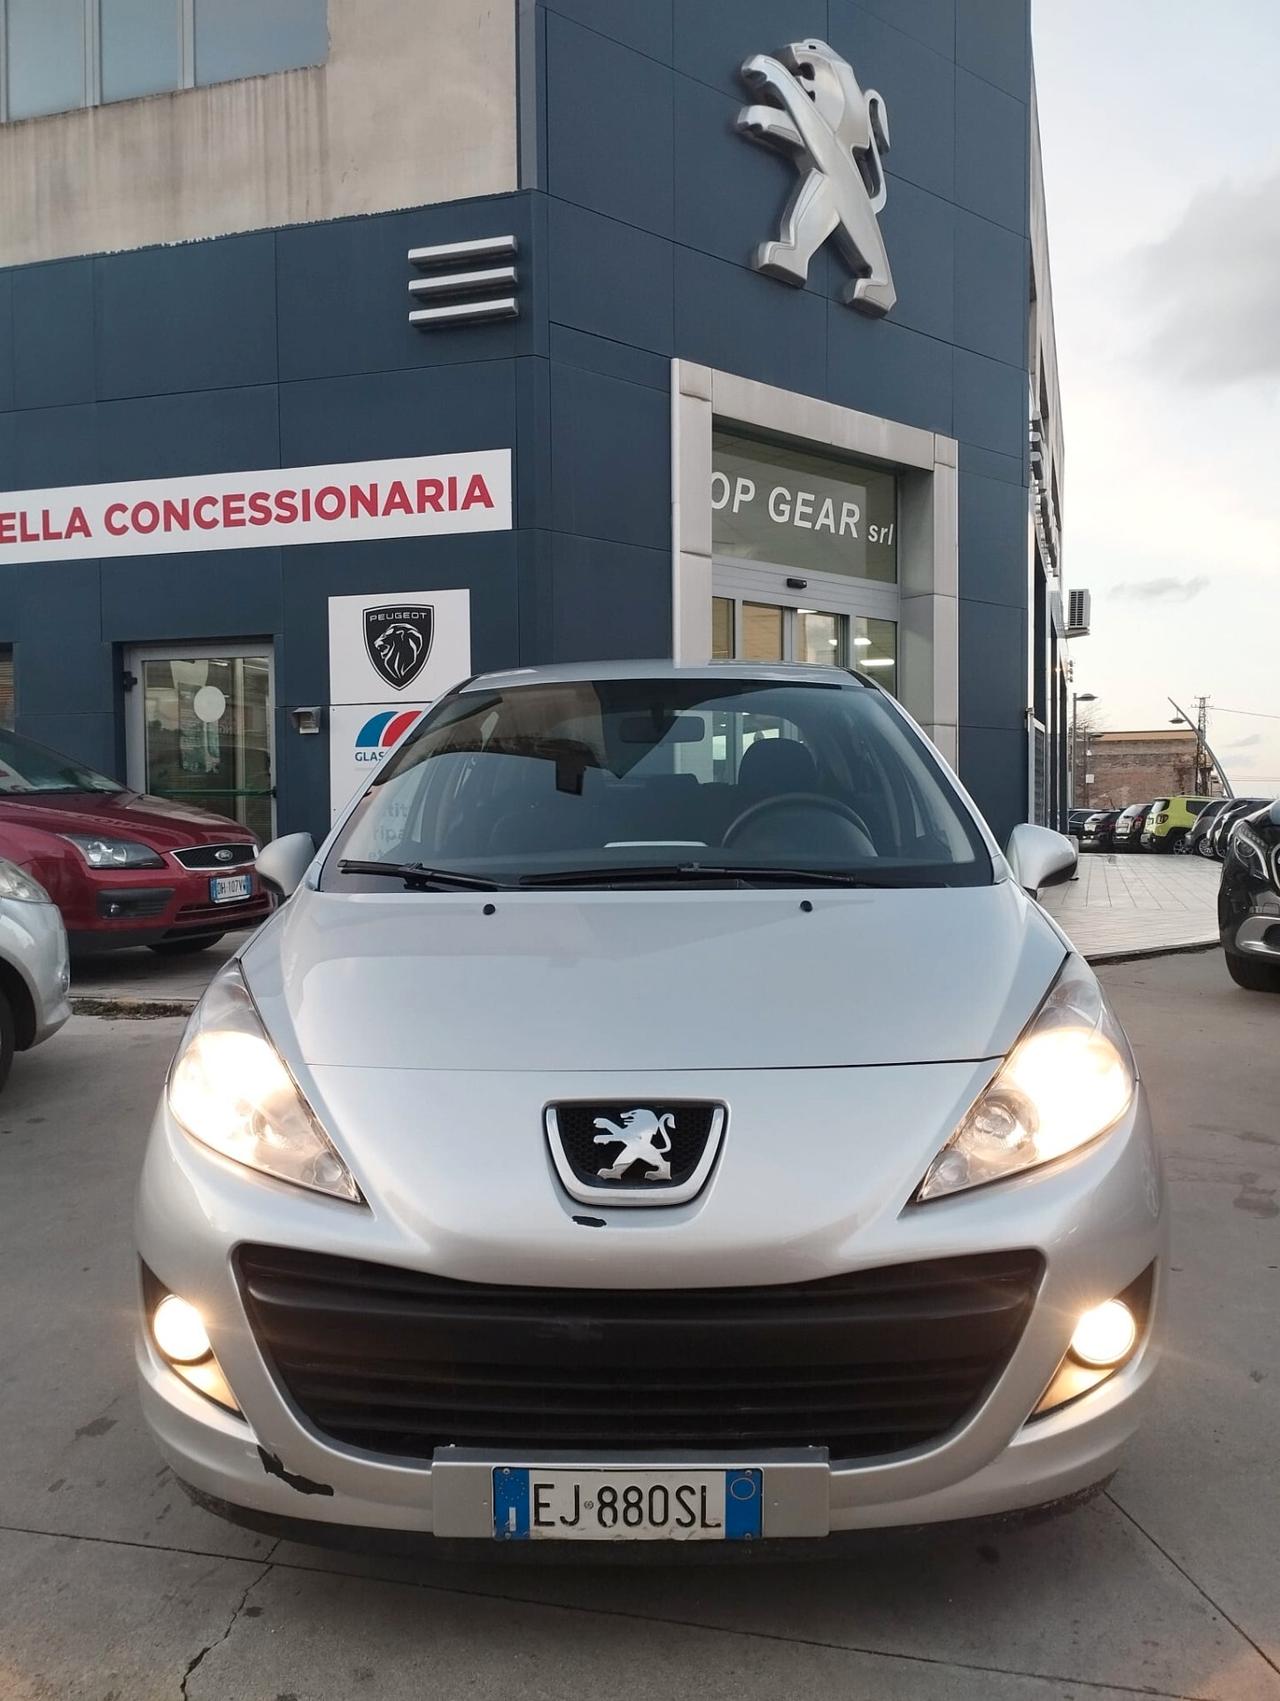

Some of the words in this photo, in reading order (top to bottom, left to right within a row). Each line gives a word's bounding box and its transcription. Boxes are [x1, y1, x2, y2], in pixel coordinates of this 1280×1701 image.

[0, 506, 93, 544] ELLA
[104, 473, 494, 537] CONCESSIONARIA
[712, 471, 756, 513] OP
[768, 486, 860, 539] GEAR
[868, 523, 894, 545] srl
[369, 612, 427, 622] PEUGEOT
[533, 1483, 581, 1528] EJ
[597, 1484, 721, 1529] 880SL
